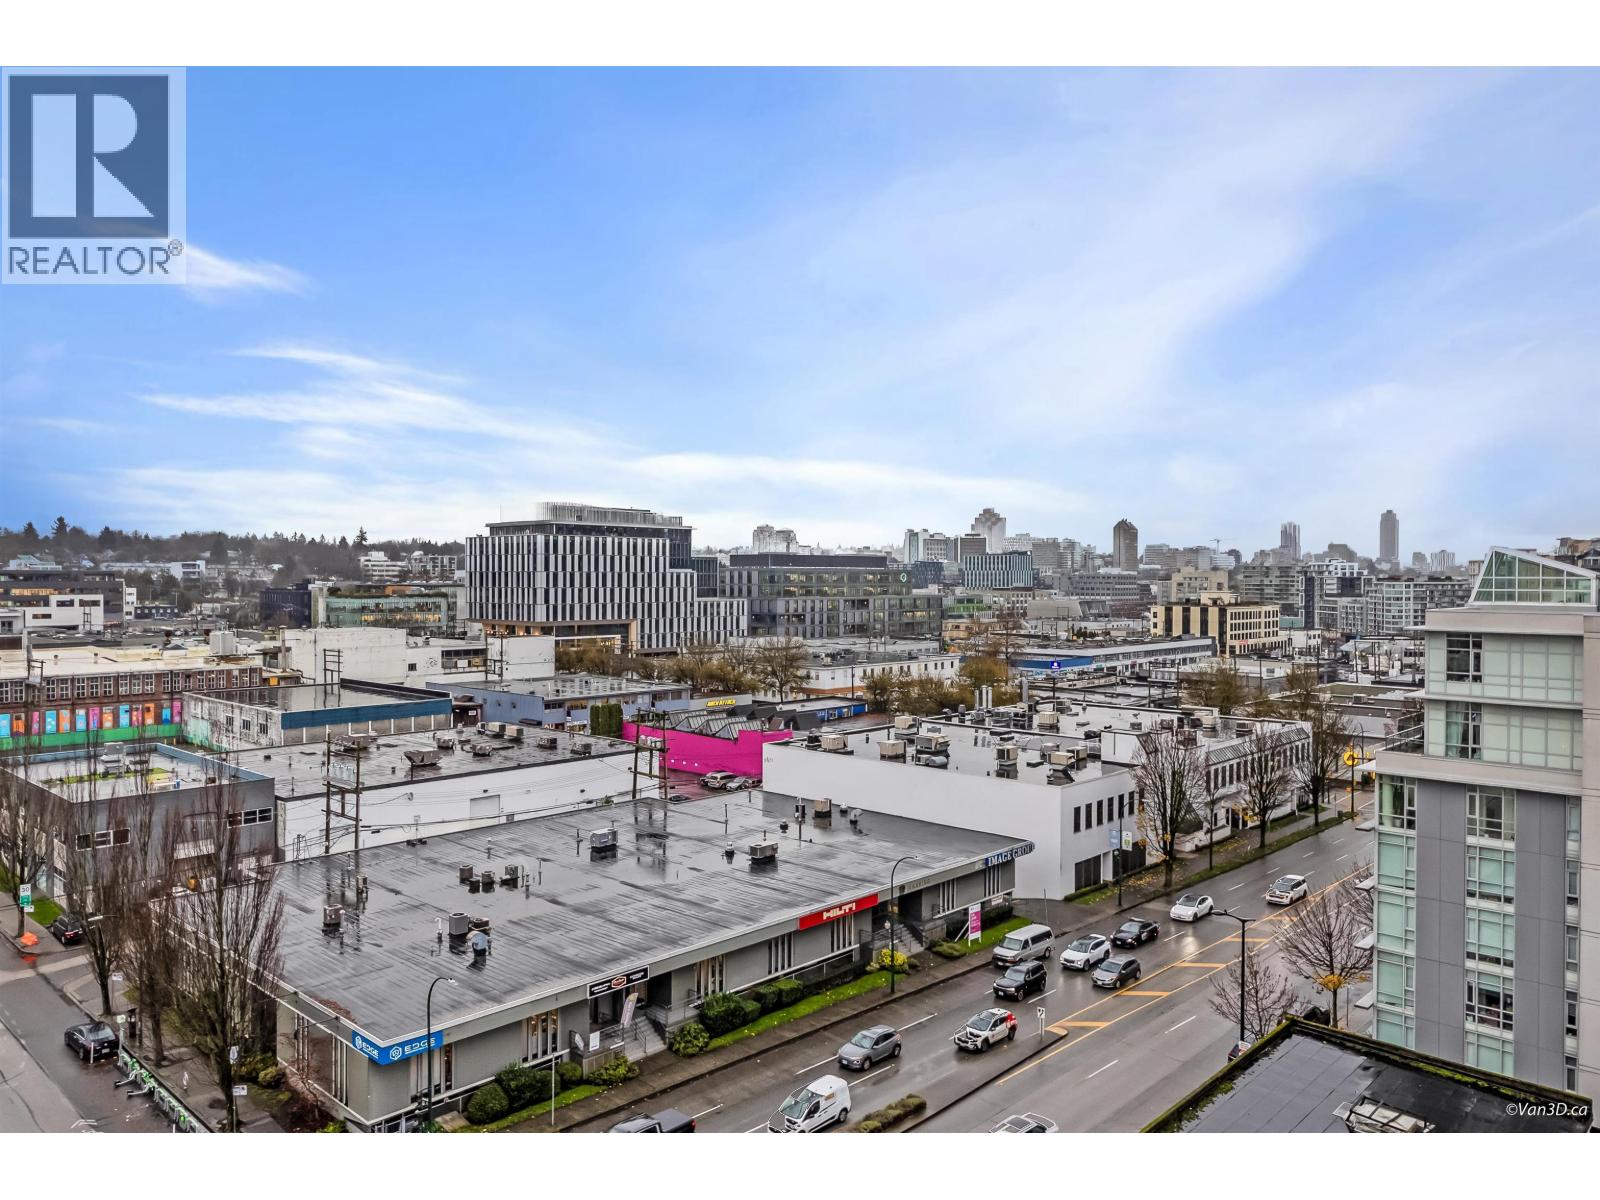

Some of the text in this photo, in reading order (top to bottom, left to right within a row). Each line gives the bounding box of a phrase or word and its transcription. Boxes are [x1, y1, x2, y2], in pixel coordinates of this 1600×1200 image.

[988, 850, 1012, 867] IMAGE
[823, 902, 856, 920] HILTI
[363, 1042, 379, 1057] EDGE
[404, 1037, 436, 1052] EDGE
